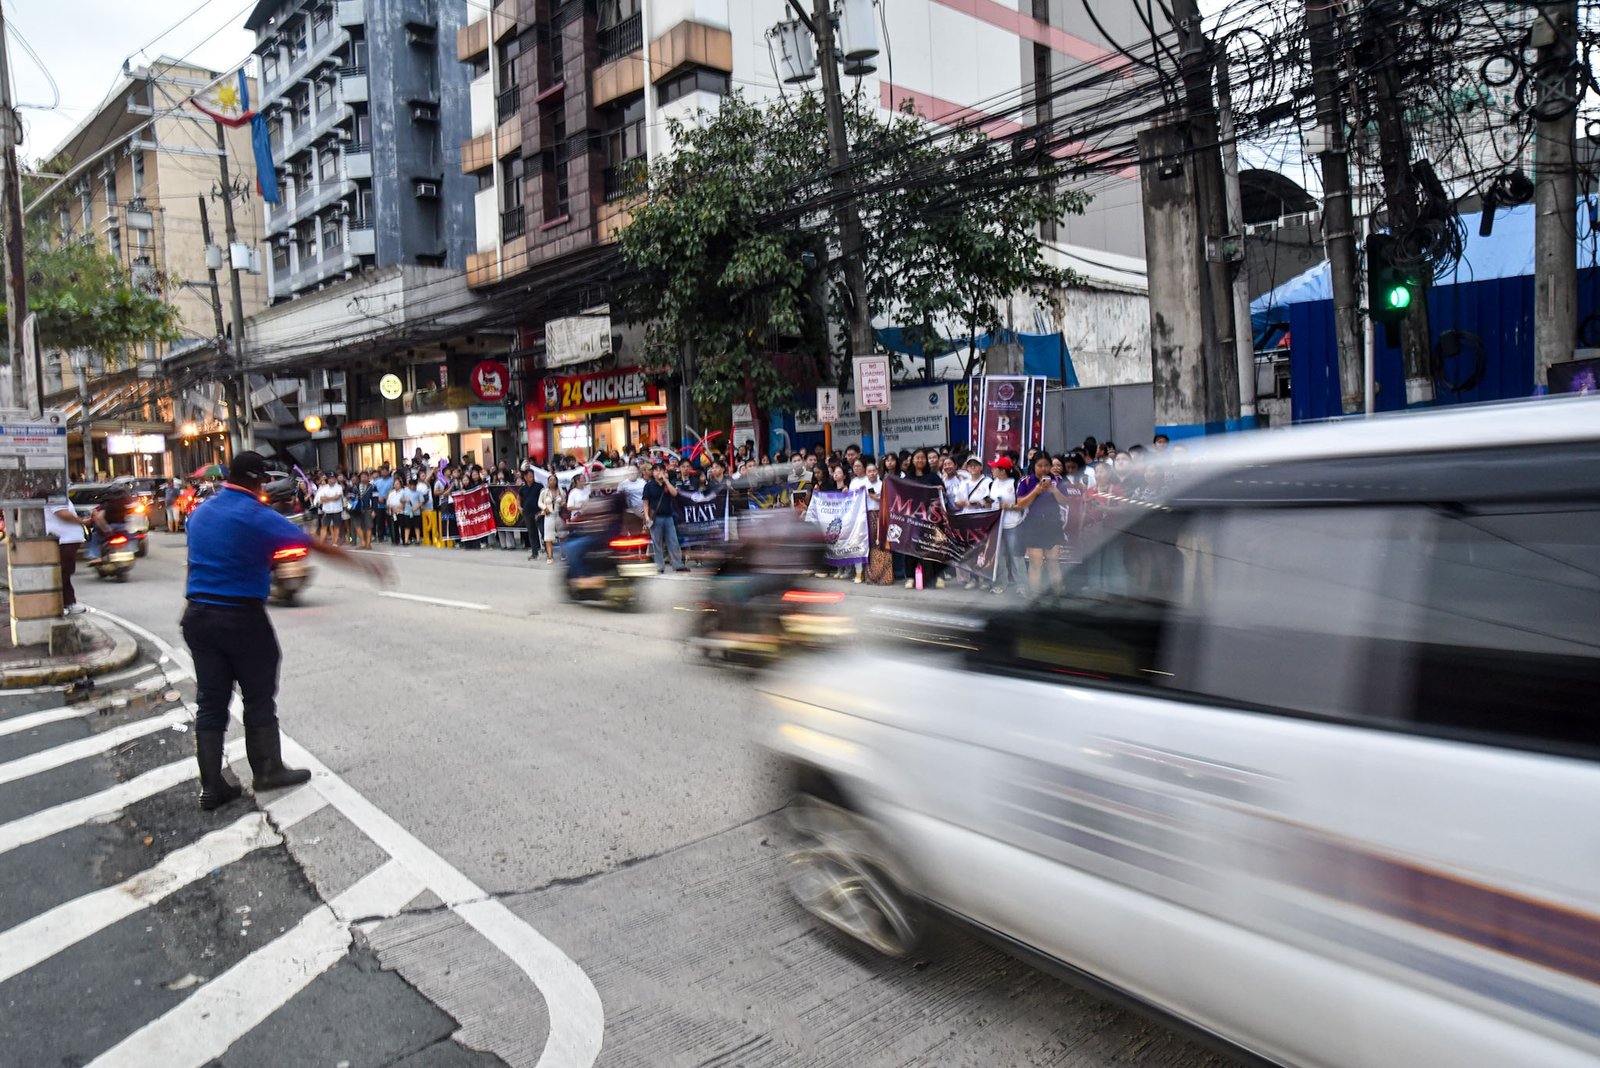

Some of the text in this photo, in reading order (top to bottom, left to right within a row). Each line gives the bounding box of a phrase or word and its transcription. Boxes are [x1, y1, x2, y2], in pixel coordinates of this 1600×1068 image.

[562, 373, 647, 407] 24 CHICKEN
[683, 503, 717, 523] FIAT
